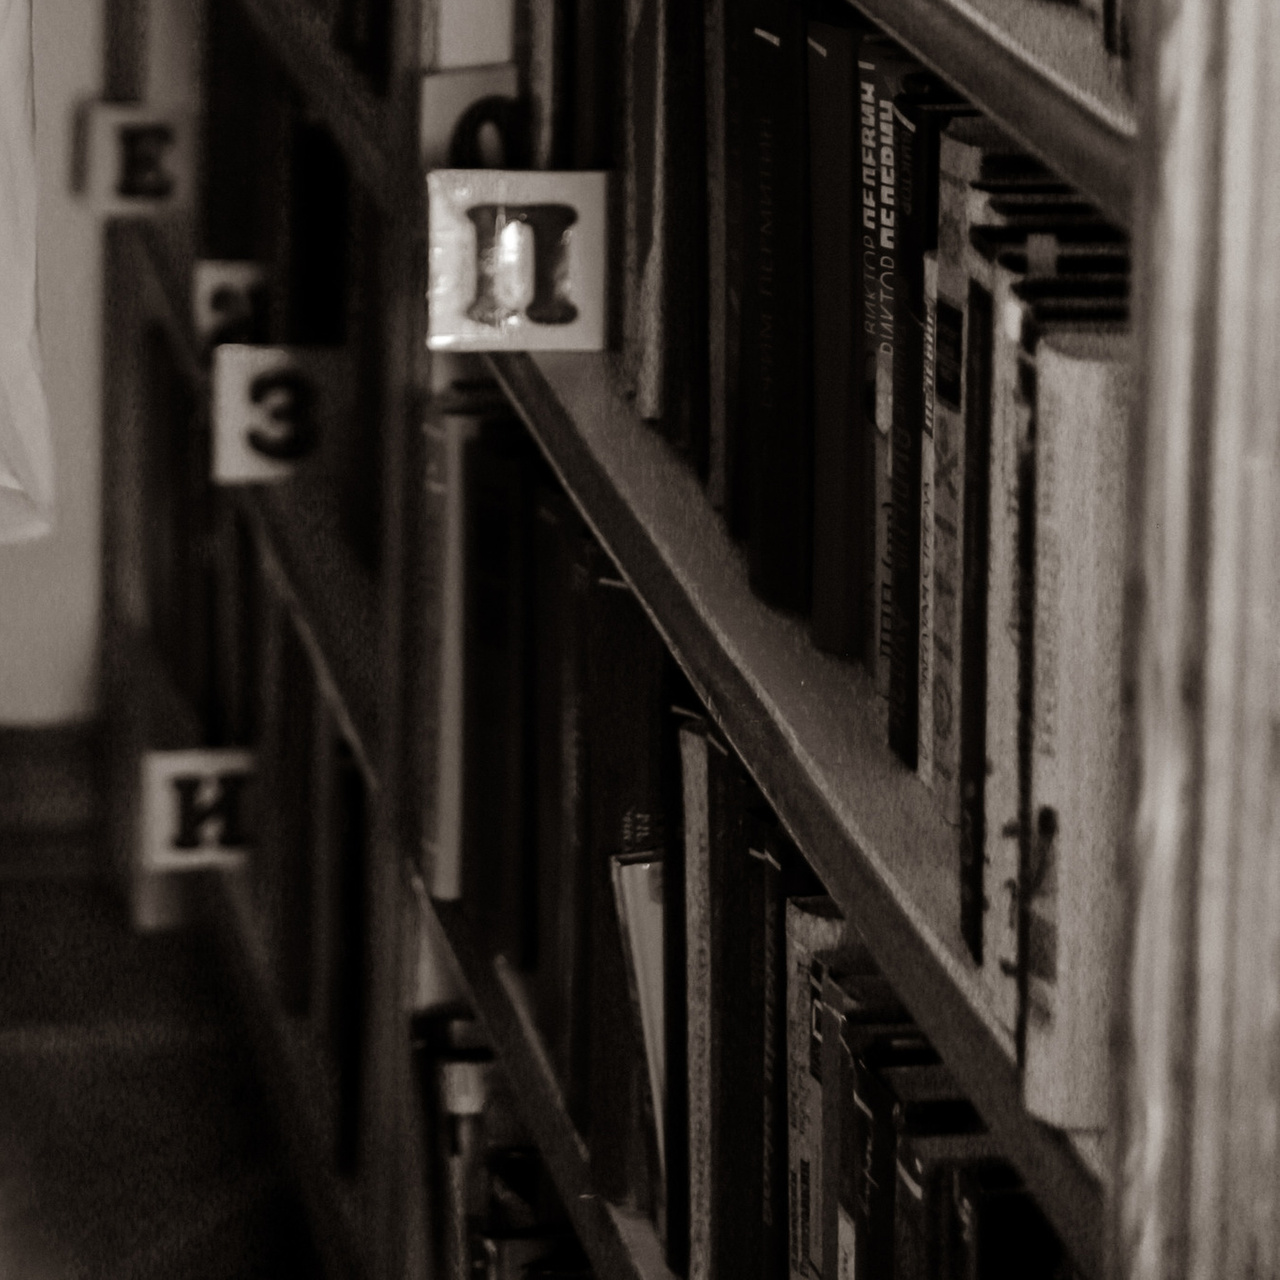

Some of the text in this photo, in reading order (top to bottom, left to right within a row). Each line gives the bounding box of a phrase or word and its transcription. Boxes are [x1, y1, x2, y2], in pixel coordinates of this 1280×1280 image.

[117, 123, 175, 197] Е
[860, 80, 877, 230] ПЕЛЕВИН
[465, 203, 579, 326] П
